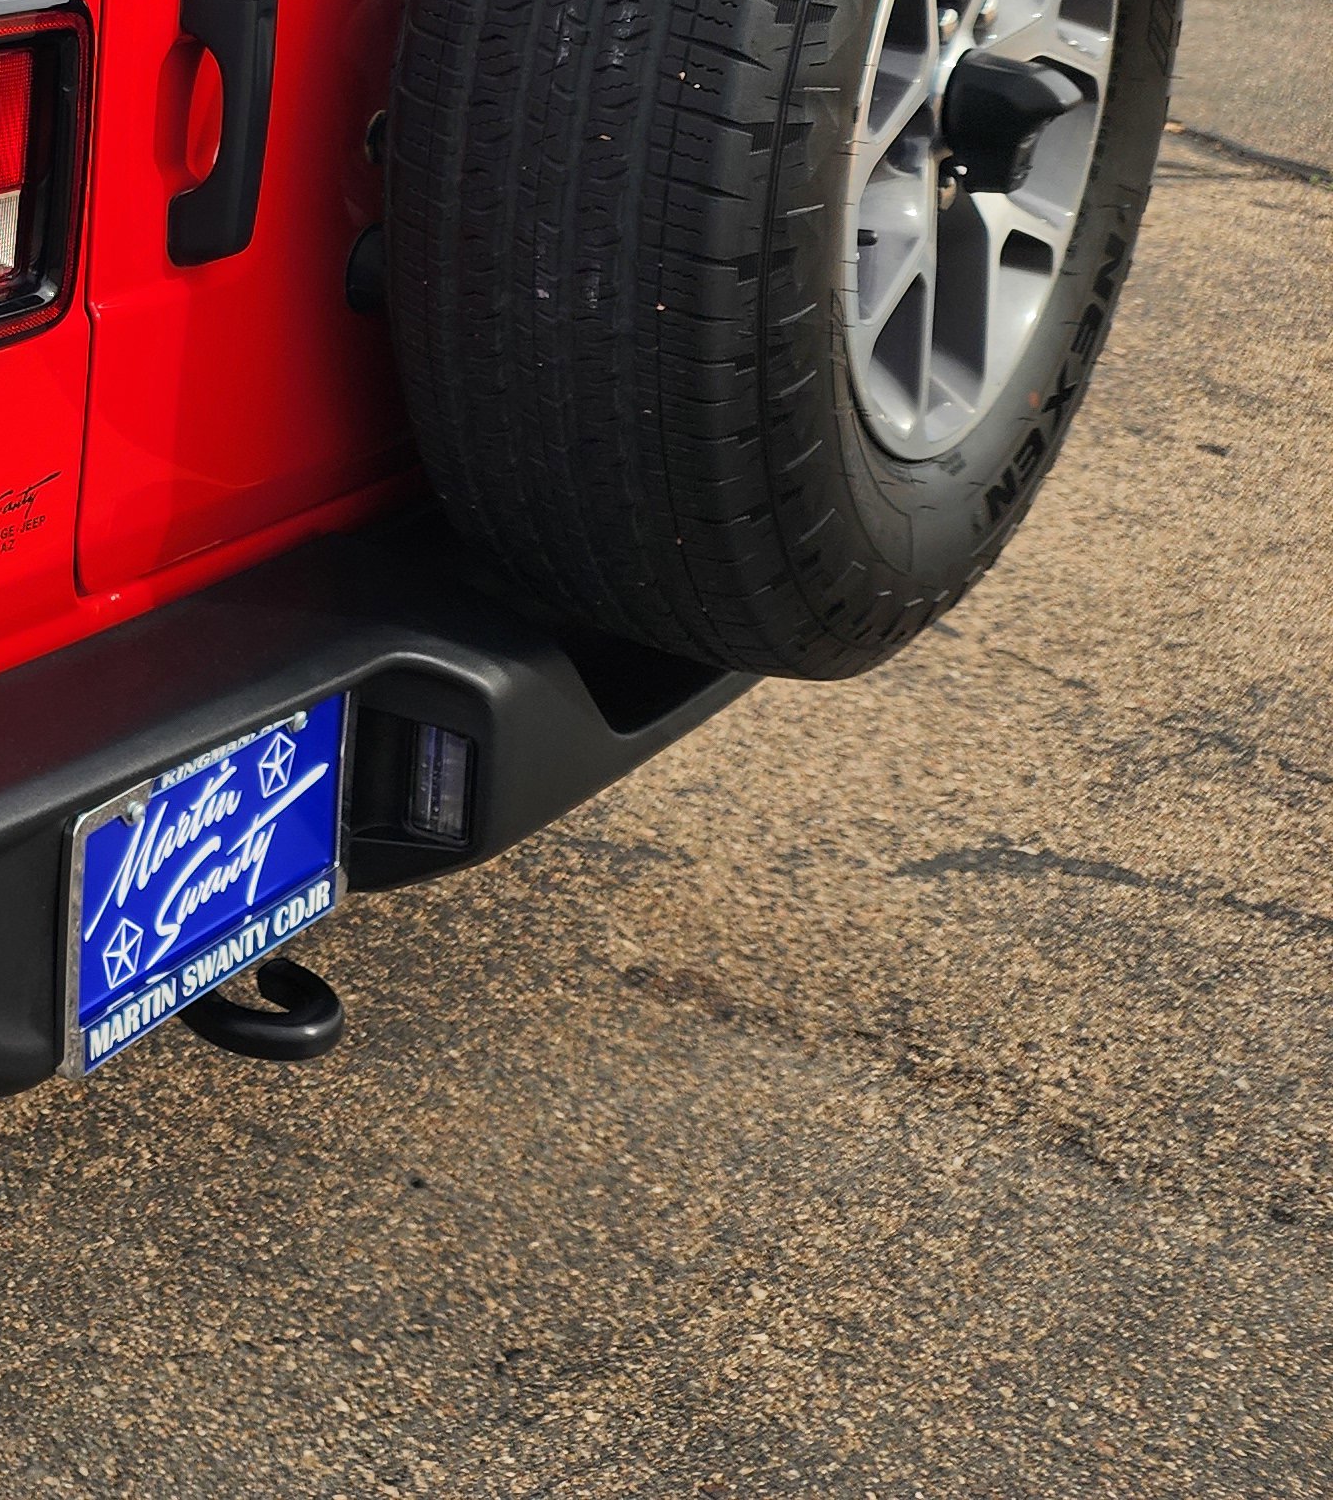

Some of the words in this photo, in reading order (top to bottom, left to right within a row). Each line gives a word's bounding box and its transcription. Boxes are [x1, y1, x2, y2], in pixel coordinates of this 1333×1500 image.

[0, 539, 15, 554] AZ
[20, 515, 46, 533] JEEP
[85, 759, 243, 943] Martin
[144, 762, 330, 971] Swanty
[89, 977, 177, 1061] MARTIN
[182, 917, 271, 999] SWANTY
[274, 879, 331, 938] CDJR
